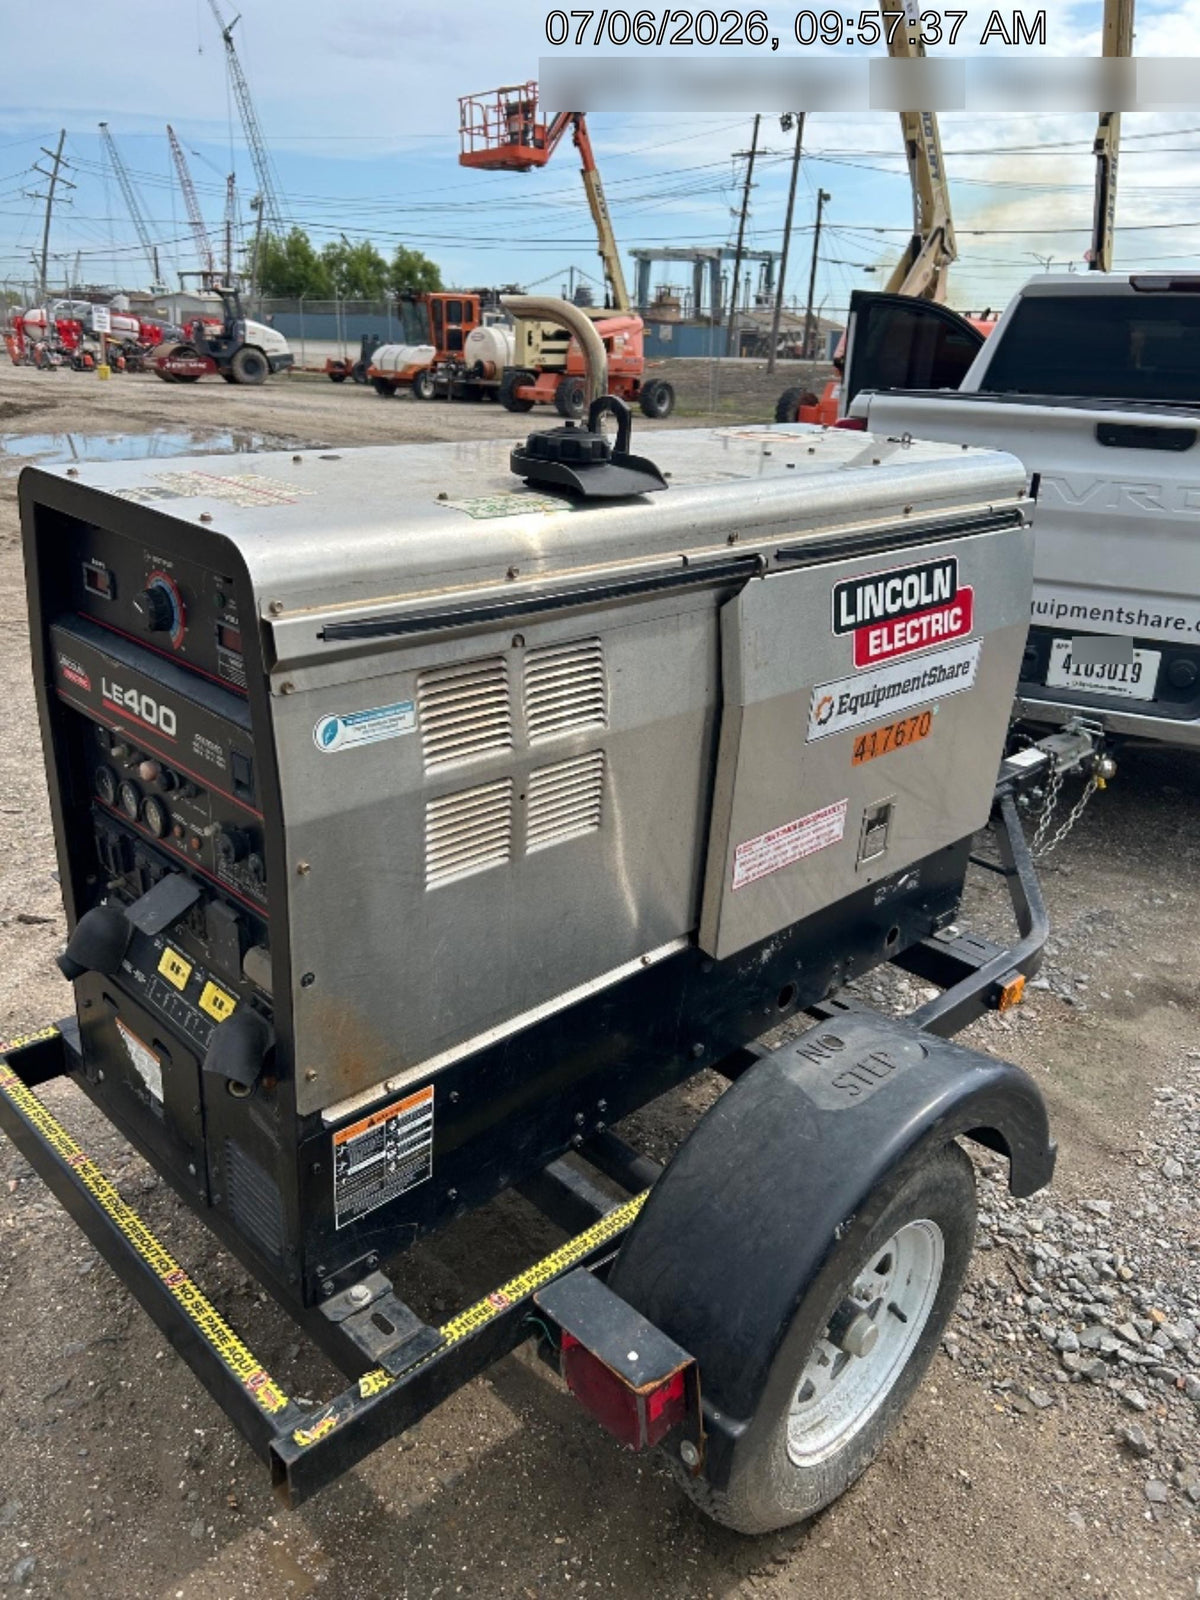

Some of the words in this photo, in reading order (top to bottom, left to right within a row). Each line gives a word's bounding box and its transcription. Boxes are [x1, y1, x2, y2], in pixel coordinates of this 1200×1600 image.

[840, 565, 951, 627] LINCOLN
[868, 606, 963, 657] ELECTRIC
[102, 677, 176, 737] LE400
[837, 659, 970, 716] EquipmentShare
[853, 710, 932, 762] 417670
[796, 1033, 847, 1066] NO
[831, 1050, 897, 1097] STEP
[124, 1218, 161, 1259] DEBOUT
[507, 1280, 526, 1298] NE
[551, 1237, 590, 1267] TENEZ
[588, 1206, 635, 1242] DEBOUT
[176, 1282, 194, 1301] NO
[190, 1299, 207, 1317] SE
[201, 1313, 231, 1347] PARE
[454, 1302, 493, 1333] HERE
